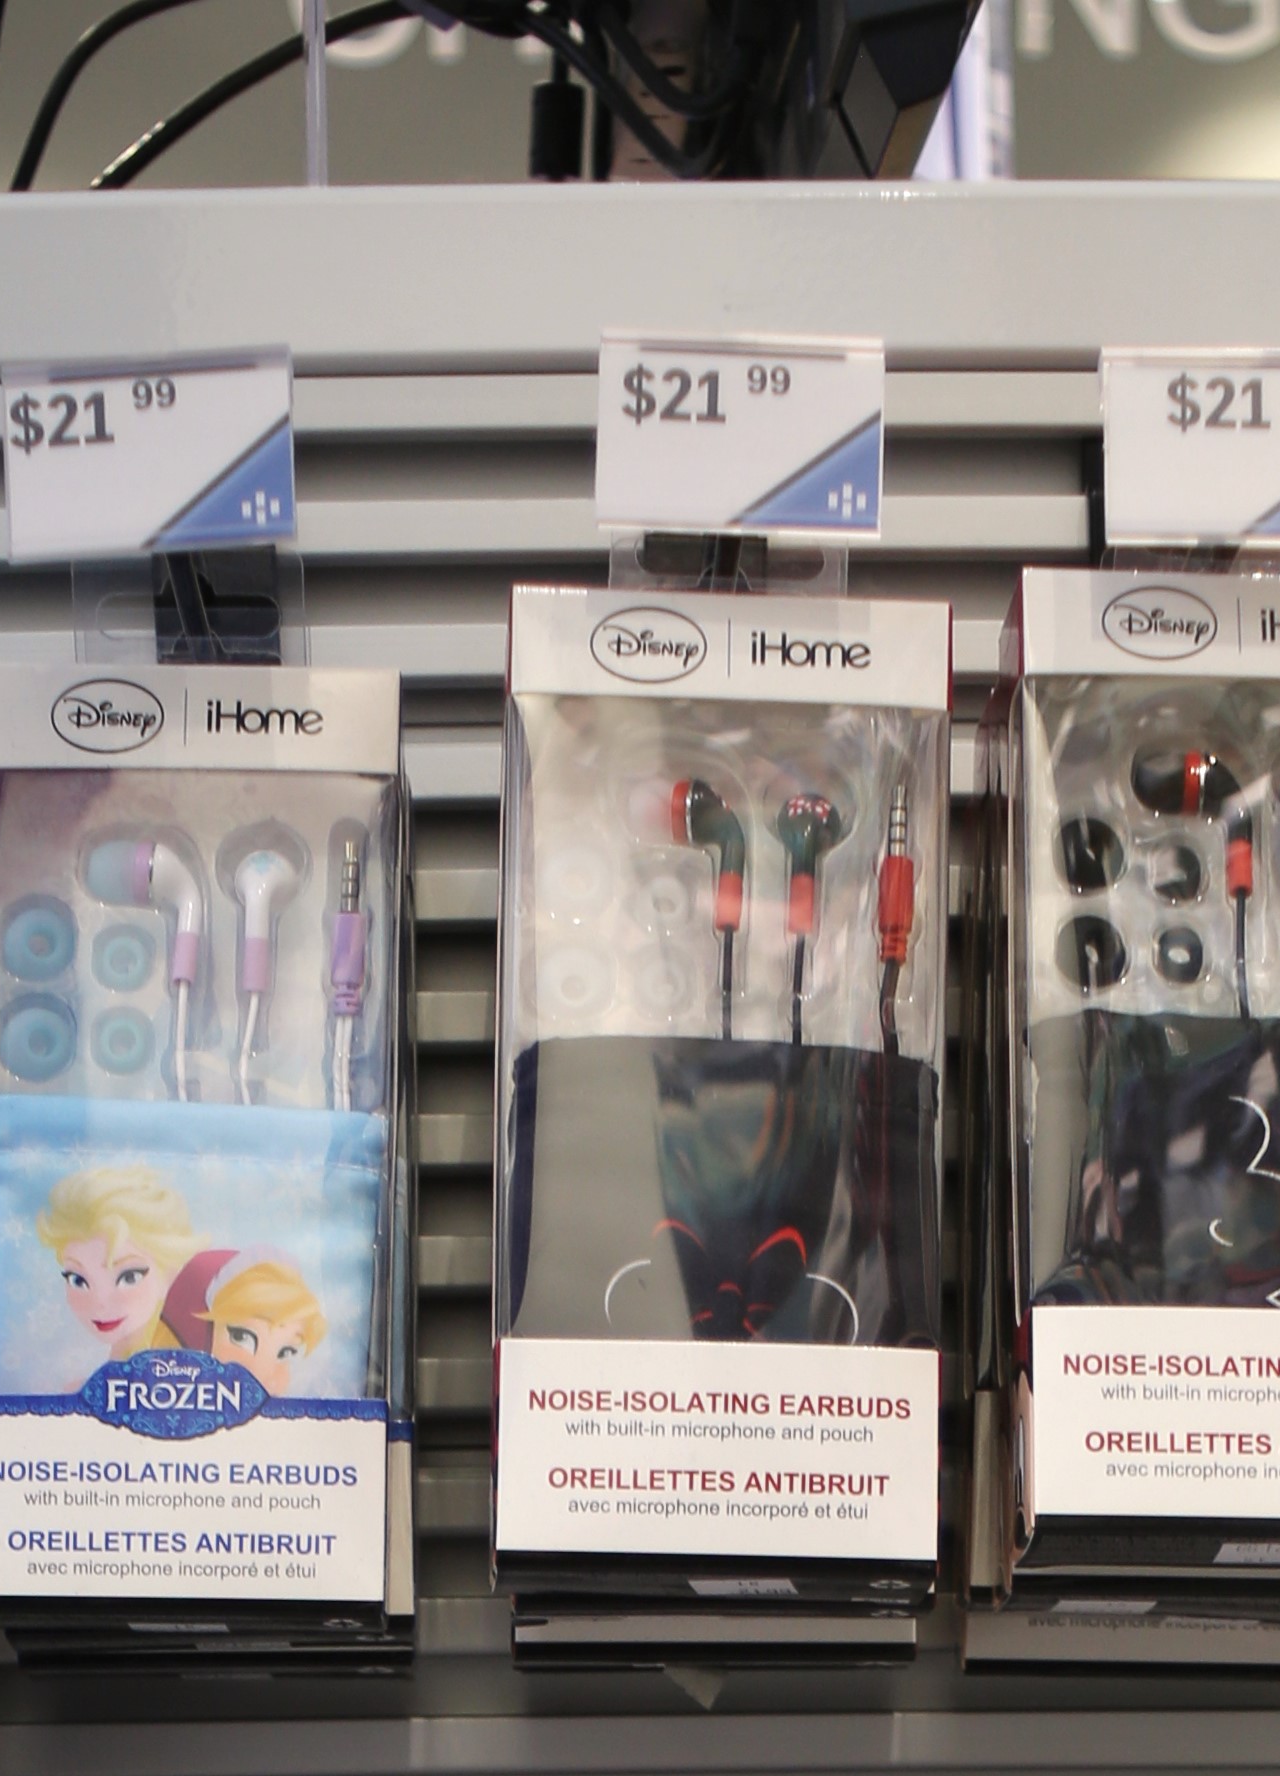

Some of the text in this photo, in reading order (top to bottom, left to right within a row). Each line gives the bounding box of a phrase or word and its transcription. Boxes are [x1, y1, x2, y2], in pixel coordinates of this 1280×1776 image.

[621, 363, 791, 424] $21 99
[1167, 373, 1271, 432] $21
[9, 378, 176, 454] $21 99
[1114, 604, 1210, 645] Disney
[604, 625, 871, 668] Disney iHome
[63, 697, 323, 737] Disney iHome
[152, 1360, 200, 1380] Disney
[107, 1378, 241, 1412] FROZEN
[528, 1389, 911, 1419] NOISE-ISOLATING EARBUDS
[1085, 1431, 1272, 1455] OREILLETTES
[229, 1464, 358, 1486] EARBUDS
[548, 1467, 889, 1496] OREILLETTES ANTIBRUIT
[24, 1490, 320, 1511] with built-in microphone and pouch
[8, 1531, 336, 1555] OREILLETTES ANTIBRUIT
[27, 1560, 316, 1579] avec microphone incorporé et étui
